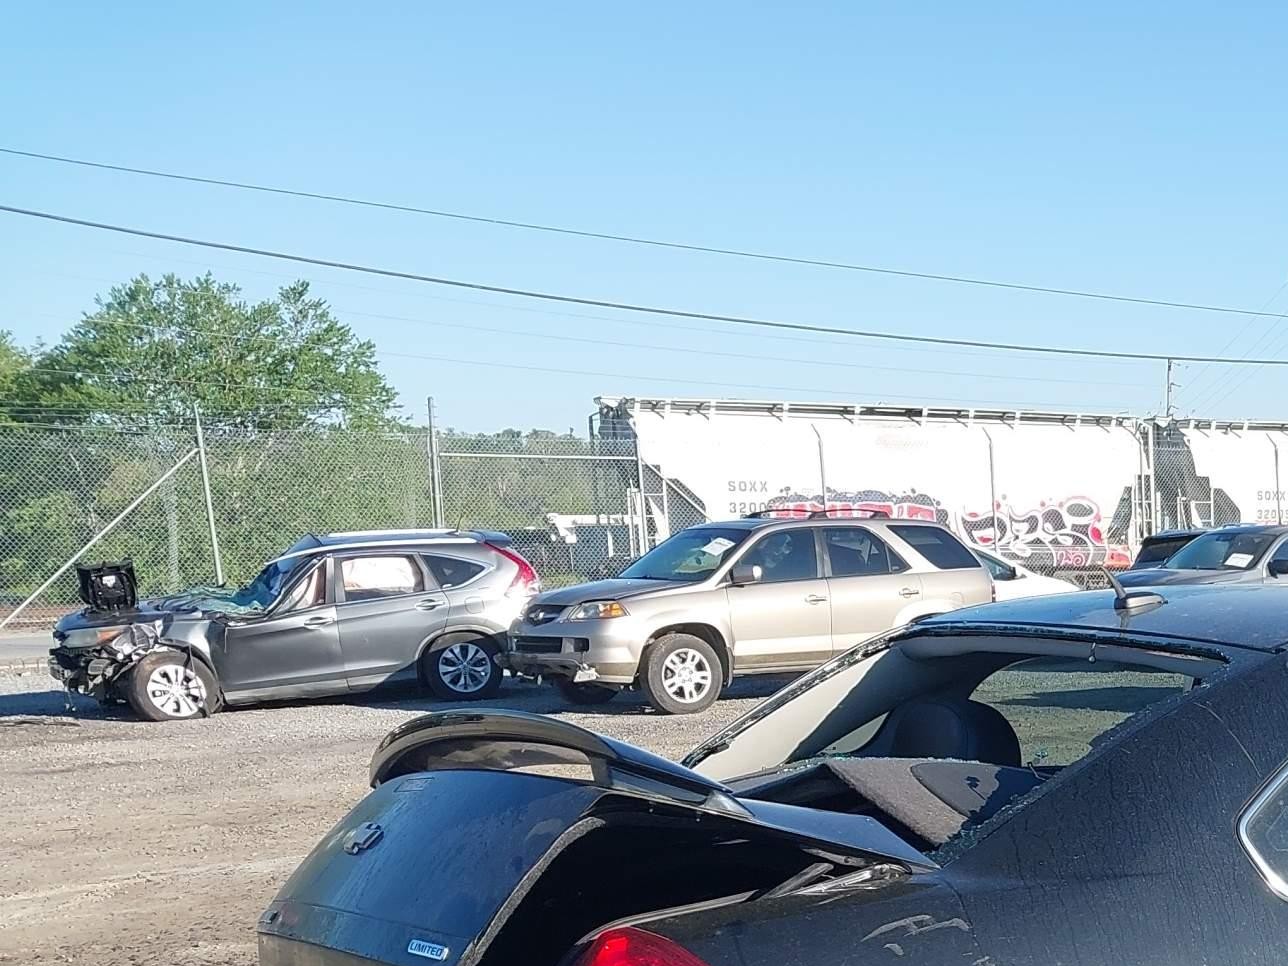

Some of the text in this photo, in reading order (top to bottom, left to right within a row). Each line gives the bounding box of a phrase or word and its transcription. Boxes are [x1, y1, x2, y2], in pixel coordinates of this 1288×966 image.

[728, 481, 768, 492] SOXX
[1257, 490, 1286, 501] SOXX
[410, 941, 444, 957] LIMITED
